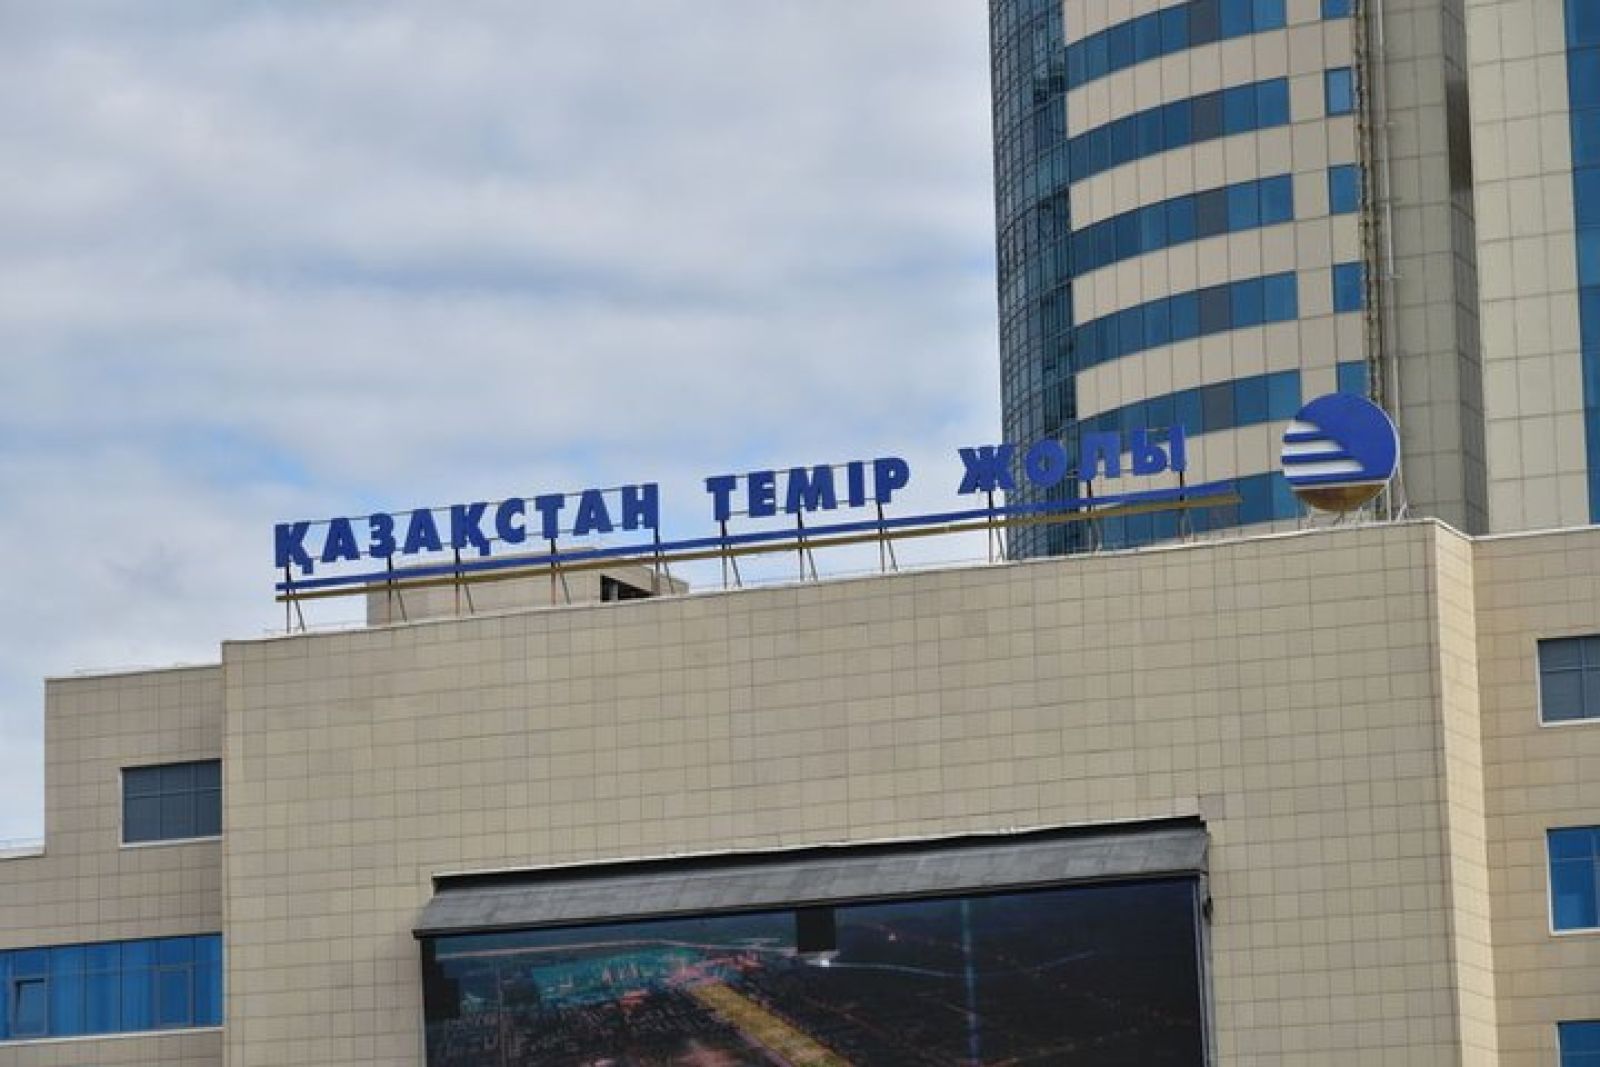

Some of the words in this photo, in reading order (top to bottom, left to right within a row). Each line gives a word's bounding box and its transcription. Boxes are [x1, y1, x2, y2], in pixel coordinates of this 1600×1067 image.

[275, 483, 658, 574] ҚАЗАҚСТАН
[706, 457, 909, 520] ТЕМІР
[958, 424, 1185, 494] ЖОЛЫ
